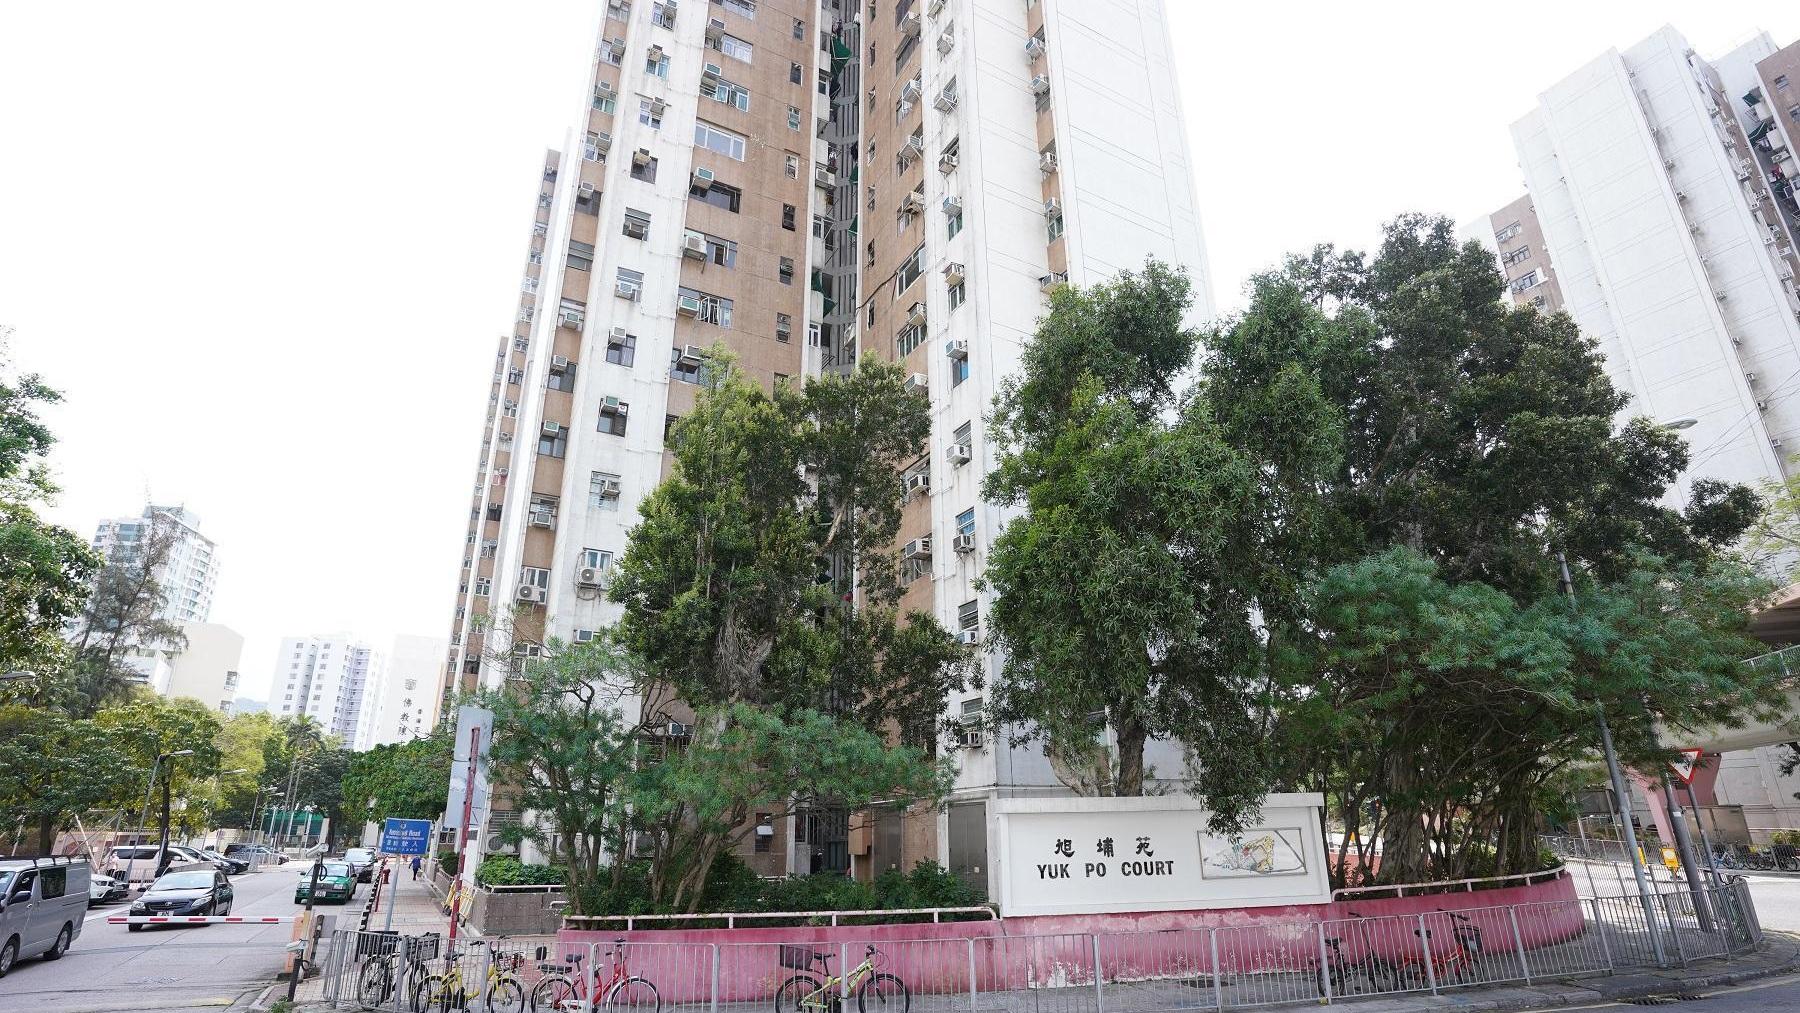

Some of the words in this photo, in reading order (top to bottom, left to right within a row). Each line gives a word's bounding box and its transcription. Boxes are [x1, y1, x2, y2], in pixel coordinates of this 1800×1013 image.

[1054, 836, 1155, 858] 旭埔苑
[1037, 863, 1071, 880] YUK
[1085, 862, 1107, 878] PO
[1121, 860, 1174, 877] COURT
